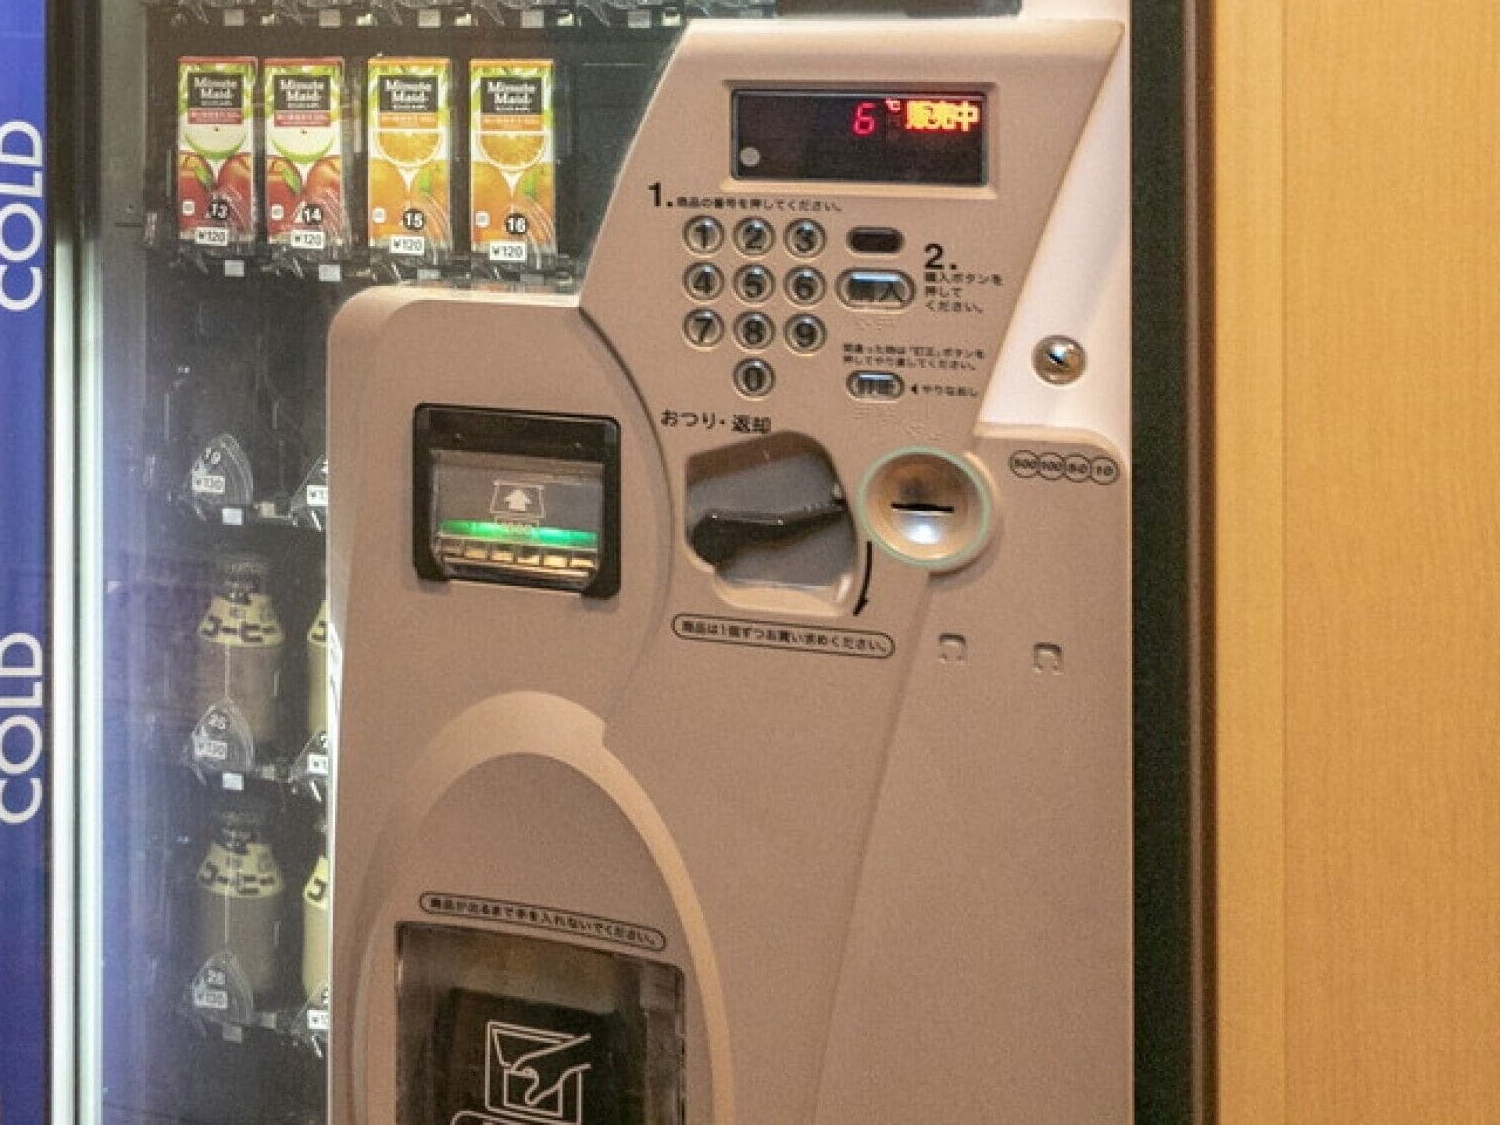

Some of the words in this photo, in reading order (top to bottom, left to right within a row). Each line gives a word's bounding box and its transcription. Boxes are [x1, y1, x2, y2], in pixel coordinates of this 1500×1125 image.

[853, 101, 877, 137] 6
[647, 182, 674, 208] 1.
[743, 226, 763, 249] 2
[795, 228, 815, 253] 3
[924, 242, 958, 271] 2.
[693, 272, 713, 294] 4
[743, 273, 763, 298] 5
[794, 275, 815, 301] 6
[695, 317, 714, 343] 7
[743, 318, 764, 345] 8
[794, 322, 817, 348] 9
[743, 366, 764, 392] 0
